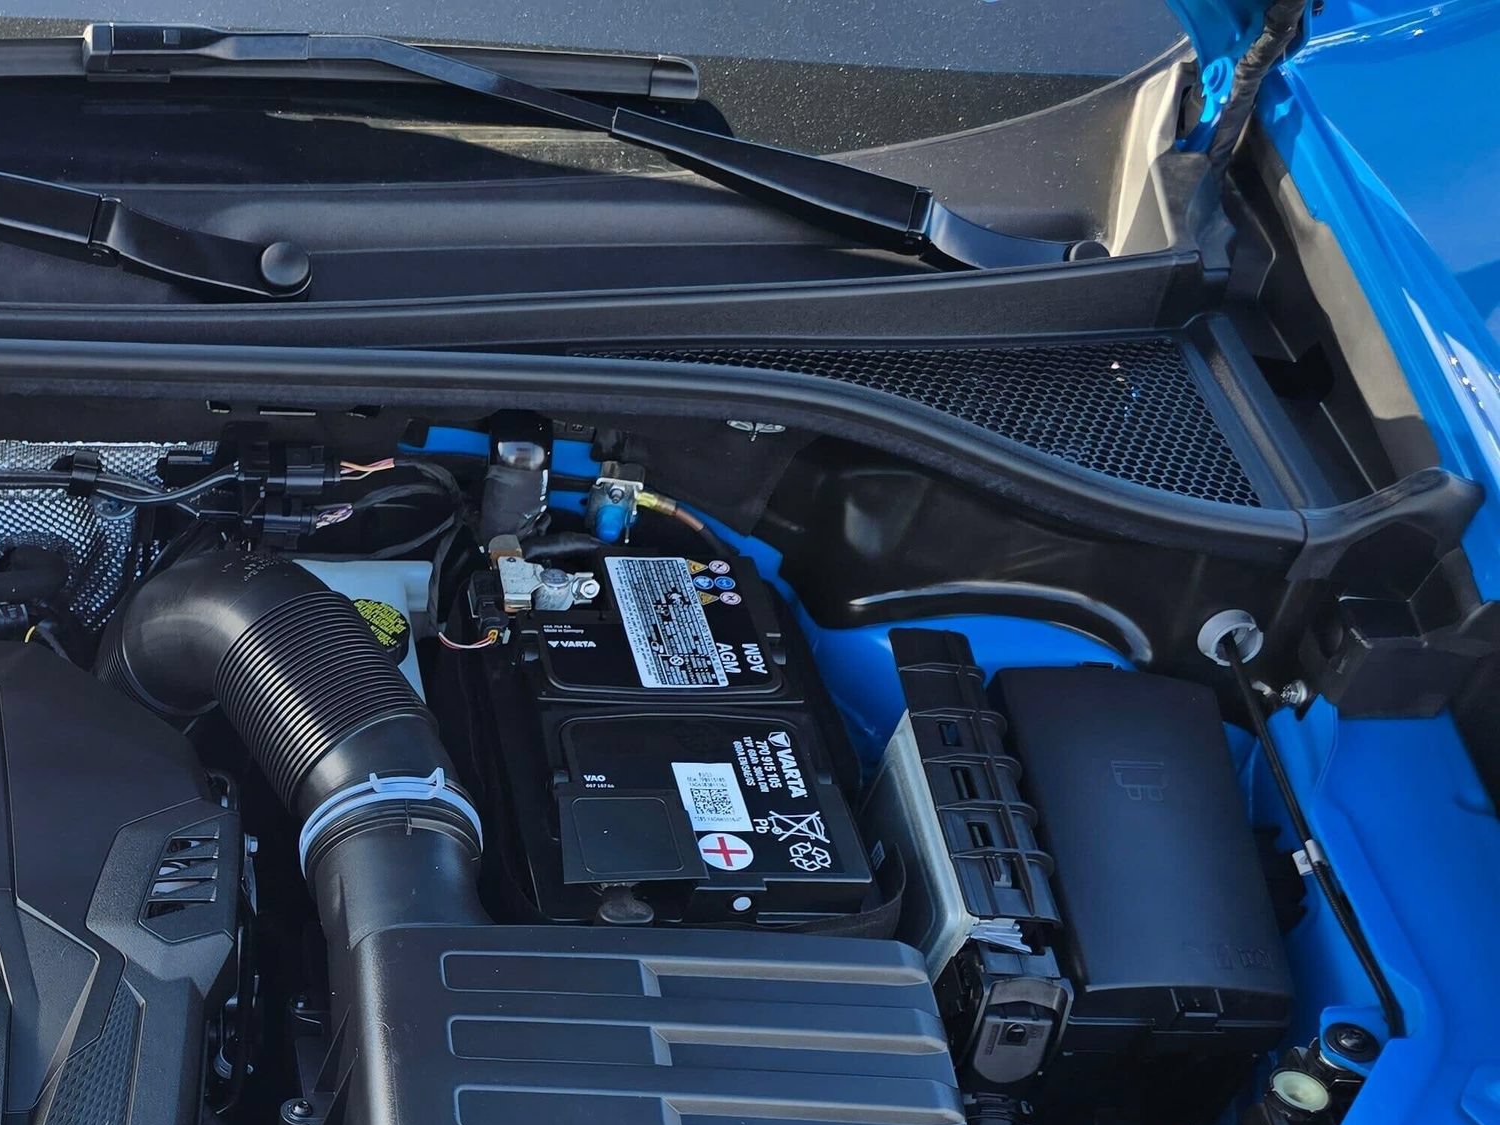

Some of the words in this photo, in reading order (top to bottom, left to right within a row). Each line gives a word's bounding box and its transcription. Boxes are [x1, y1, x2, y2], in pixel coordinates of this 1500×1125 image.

[560, 640, 597, 648] VARTA
[716, 642, 741, 673] AGM
[742, 643, 768, 674] AGM
[761, 757, 777, 771] 915
[584, 774, 606, 782] VAO
[767, 773, 782, 788] 105
[777, 748, 808, 798] VARTA
[753, 819, 770, 834] Pb
